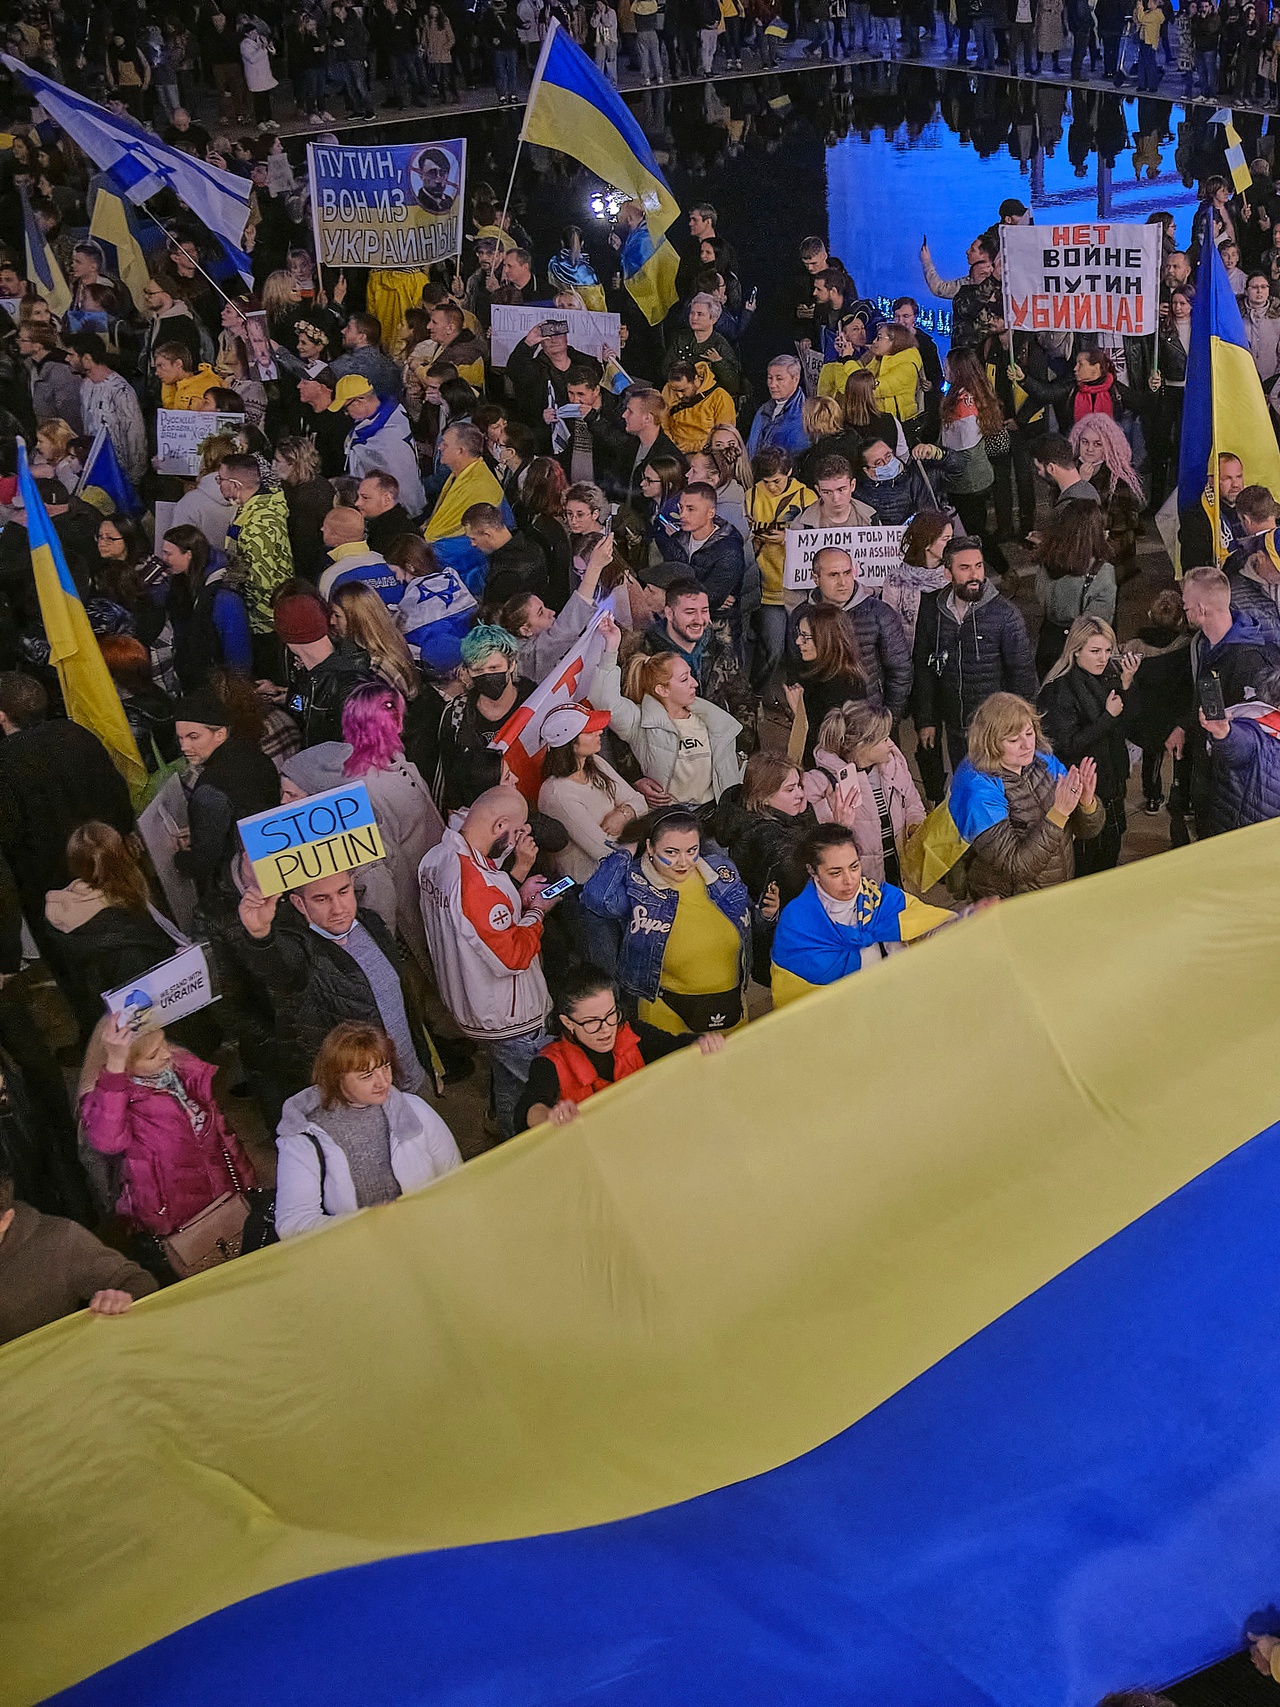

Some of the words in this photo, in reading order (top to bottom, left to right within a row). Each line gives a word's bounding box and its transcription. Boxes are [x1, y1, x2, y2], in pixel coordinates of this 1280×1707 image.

[317, 150, 402, 184] ПУТИН,
[322, 188, 371, 223] ВОН
[373, 188, 408, 223] ИЗ
[323, 216, 458, 264] УКРАИНЫ!
[1052, 225, 1111, 247] НЕТ
[1043, 244, 1142, 268] ВОЙНЕ
[1044, 274, 1142, 295] ПУТИН
[1011, 292, 1143, 334] УБИЙЦА!
[798, 533, 819, 548] MY
[823, 532, 852, 546] MOM
[858, 531, 883, 543] TOLD
[887, 530, 902, 542] ME
[854, 548, 867, 559] AN
[869, 545, 903, 558] ASSHOL
[679, 739, 704, 751] ASA
[260, 797, 360, 854] STOP
[274, 826, 379, 889] PUTIN
[160, 977, 204, 1009] UKRAINE
[168, 978, 188, 994] STAND
[187, 970, 202, 983] WITH
